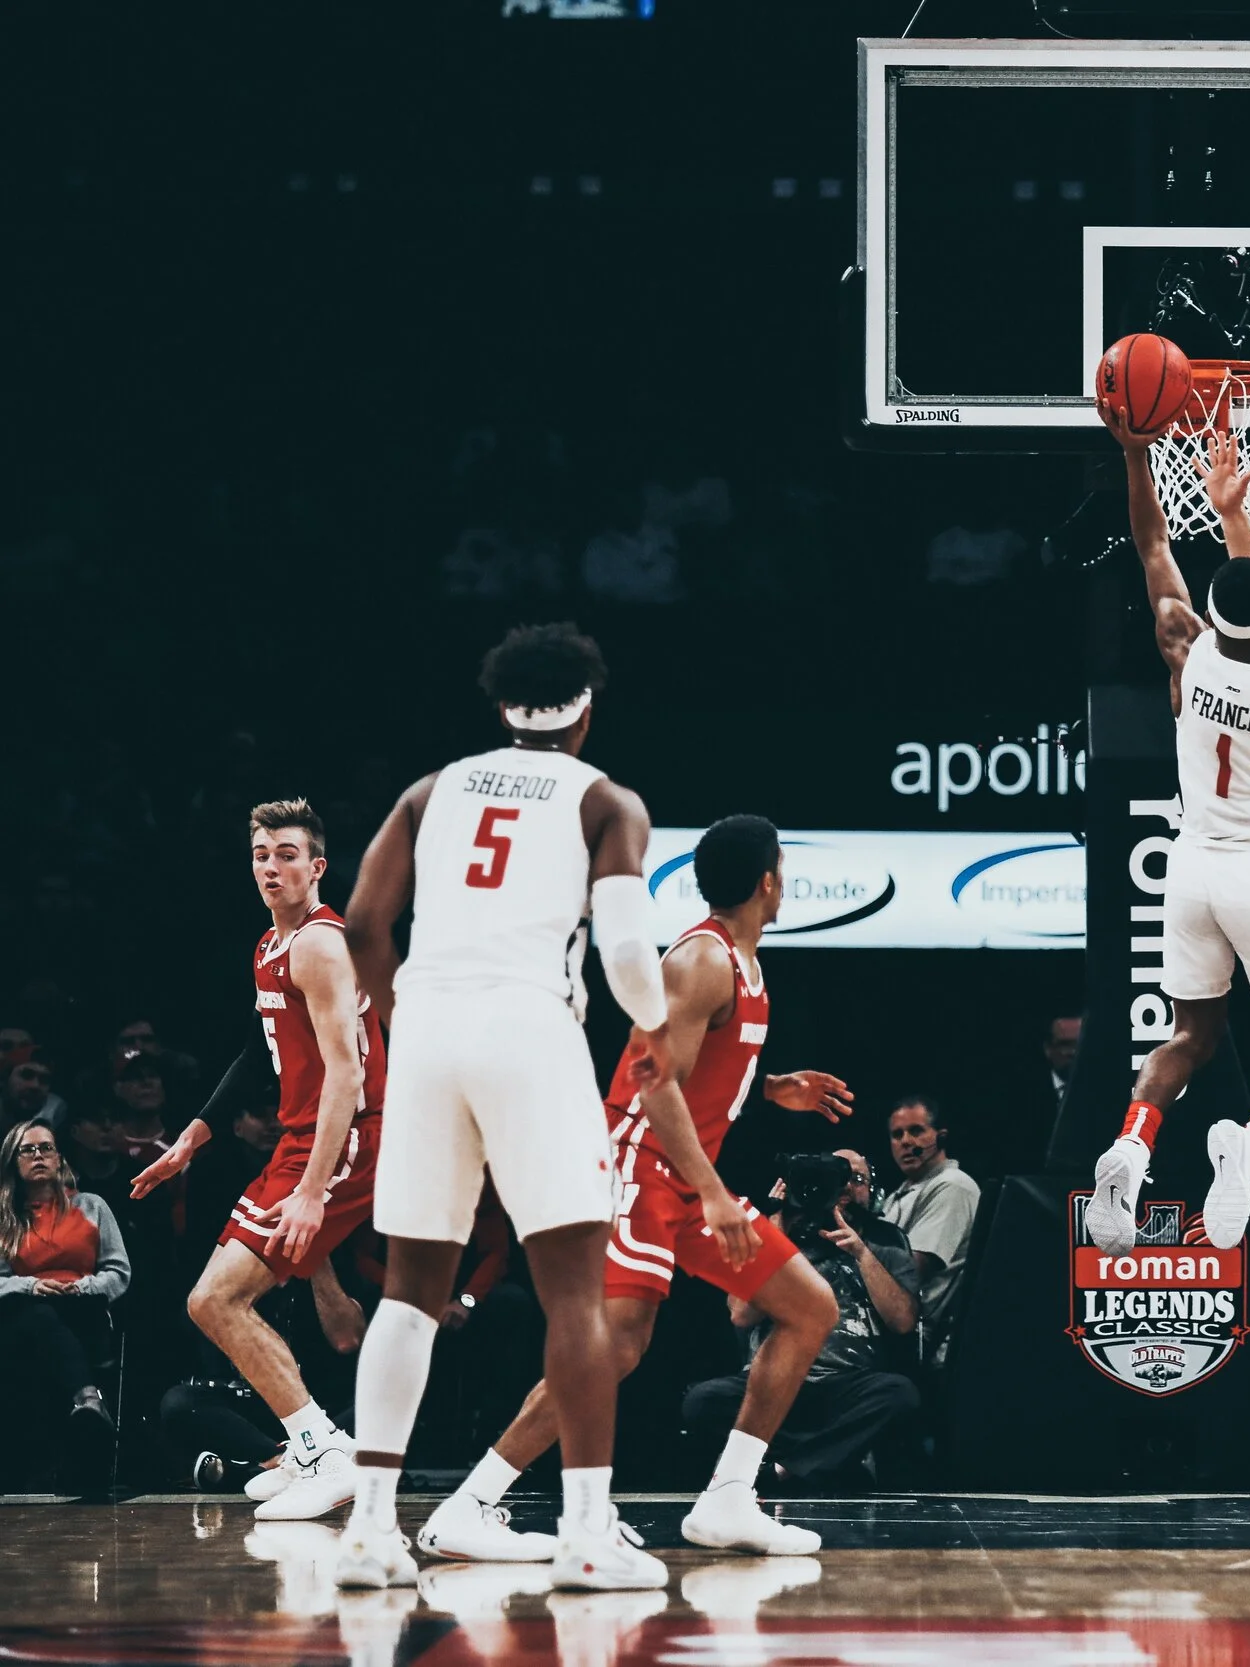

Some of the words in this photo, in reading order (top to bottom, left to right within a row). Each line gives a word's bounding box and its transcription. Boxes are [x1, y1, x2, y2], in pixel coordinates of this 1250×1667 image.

[896, 408, 961, 423] SPALDING
[891, 723, 1086, 813] apoll
[1216, 733, 1232, 799] 1
[463, 770, 557, 801] SHEROD
[465, 806, 520, 889] 5
[981, 880, 1086, 907] Imperia
[1129, 793, 1188, 1101] roma
[1097, 1256, 1220, 1280] roman
[1084, 1290, 1235, 1323] LEGENDS
[1093, 1321, 1221, 1337] CLASSIC
